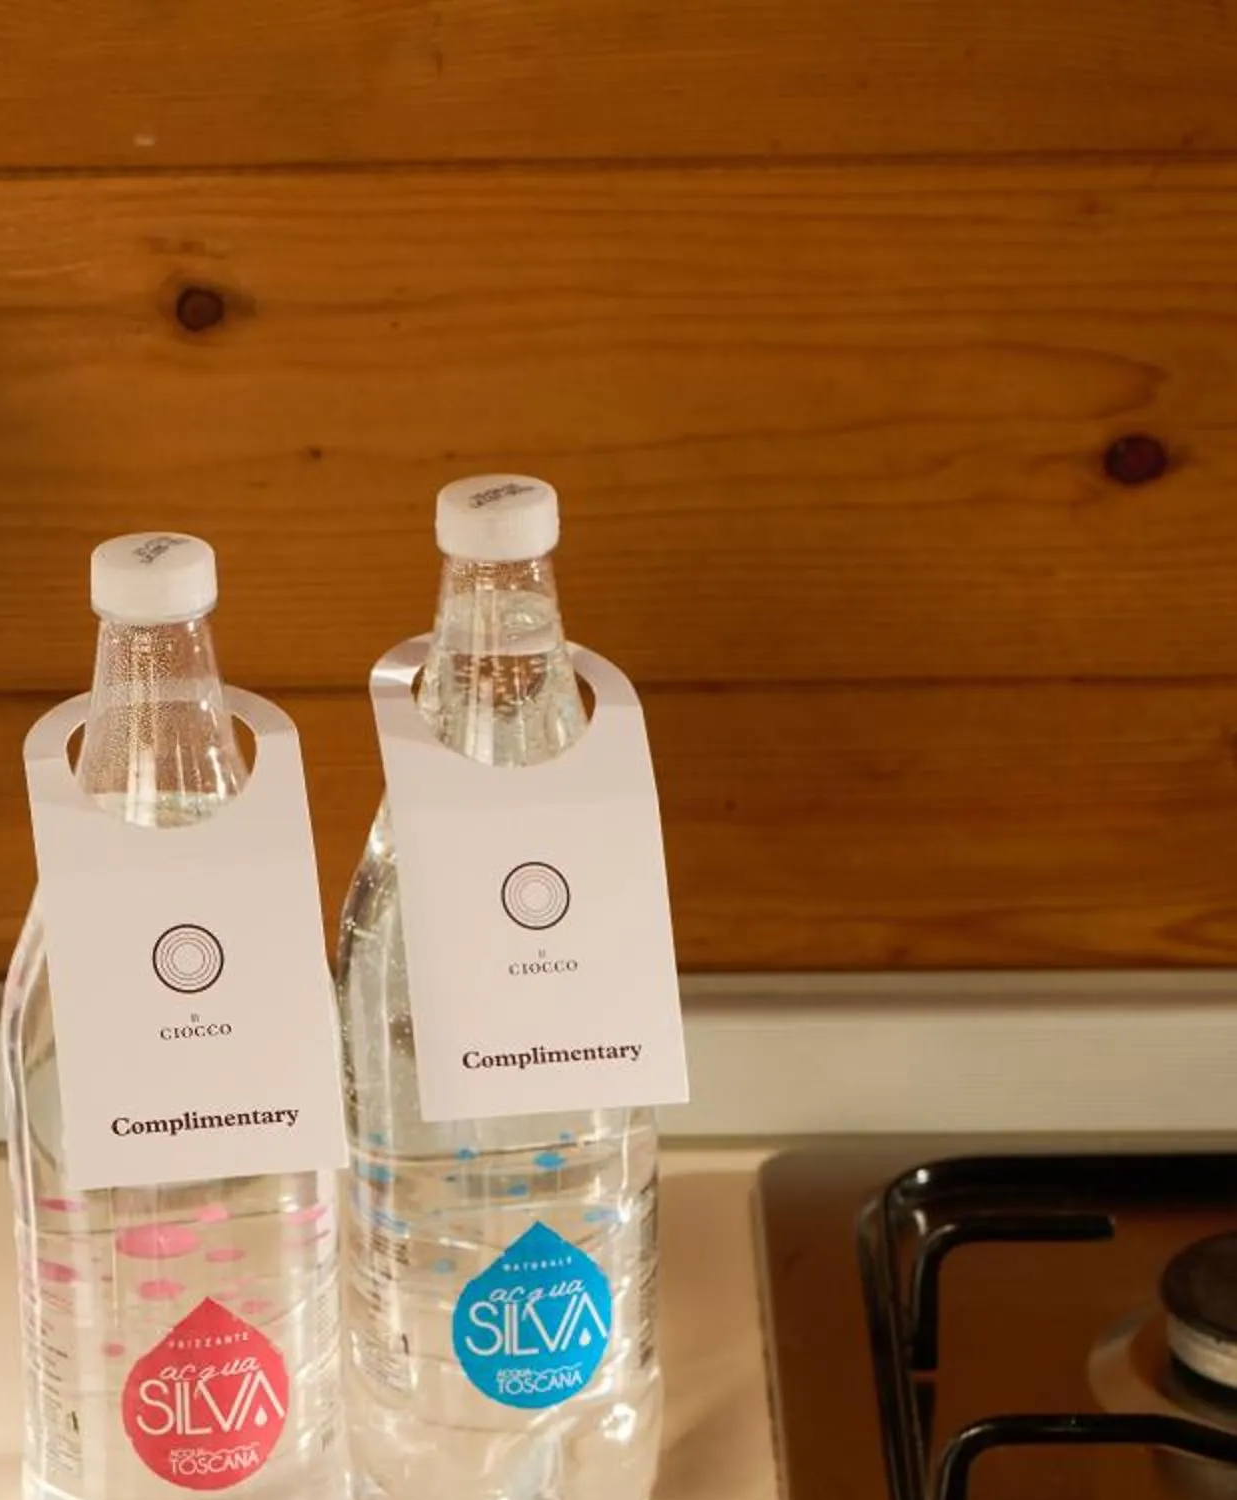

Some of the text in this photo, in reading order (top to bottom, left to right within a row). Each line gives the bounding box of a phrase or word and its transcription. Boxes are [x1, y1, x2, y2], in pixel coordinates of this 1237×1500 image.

[508, 960, 578, 975] CIOCCO
[160, 1023, 232, 1040] CIOCCO
[462, 1044, 642, 1069] Complimentary
[111, 1109, 299, 1136] Complimentary
[489, 1279, 586, 1321] acqua
[465, 1291, 608, 1356] SILVA
[169, 1331, 250, 1349] FRIZZANTE
[159, 1356, 260, 1399] acqua
[498, 1370, 584, 1394] TOSCANA
[136, 1370, 286, 1435] SILVA
[170, 1449, 261, 1475] TOSCANA
